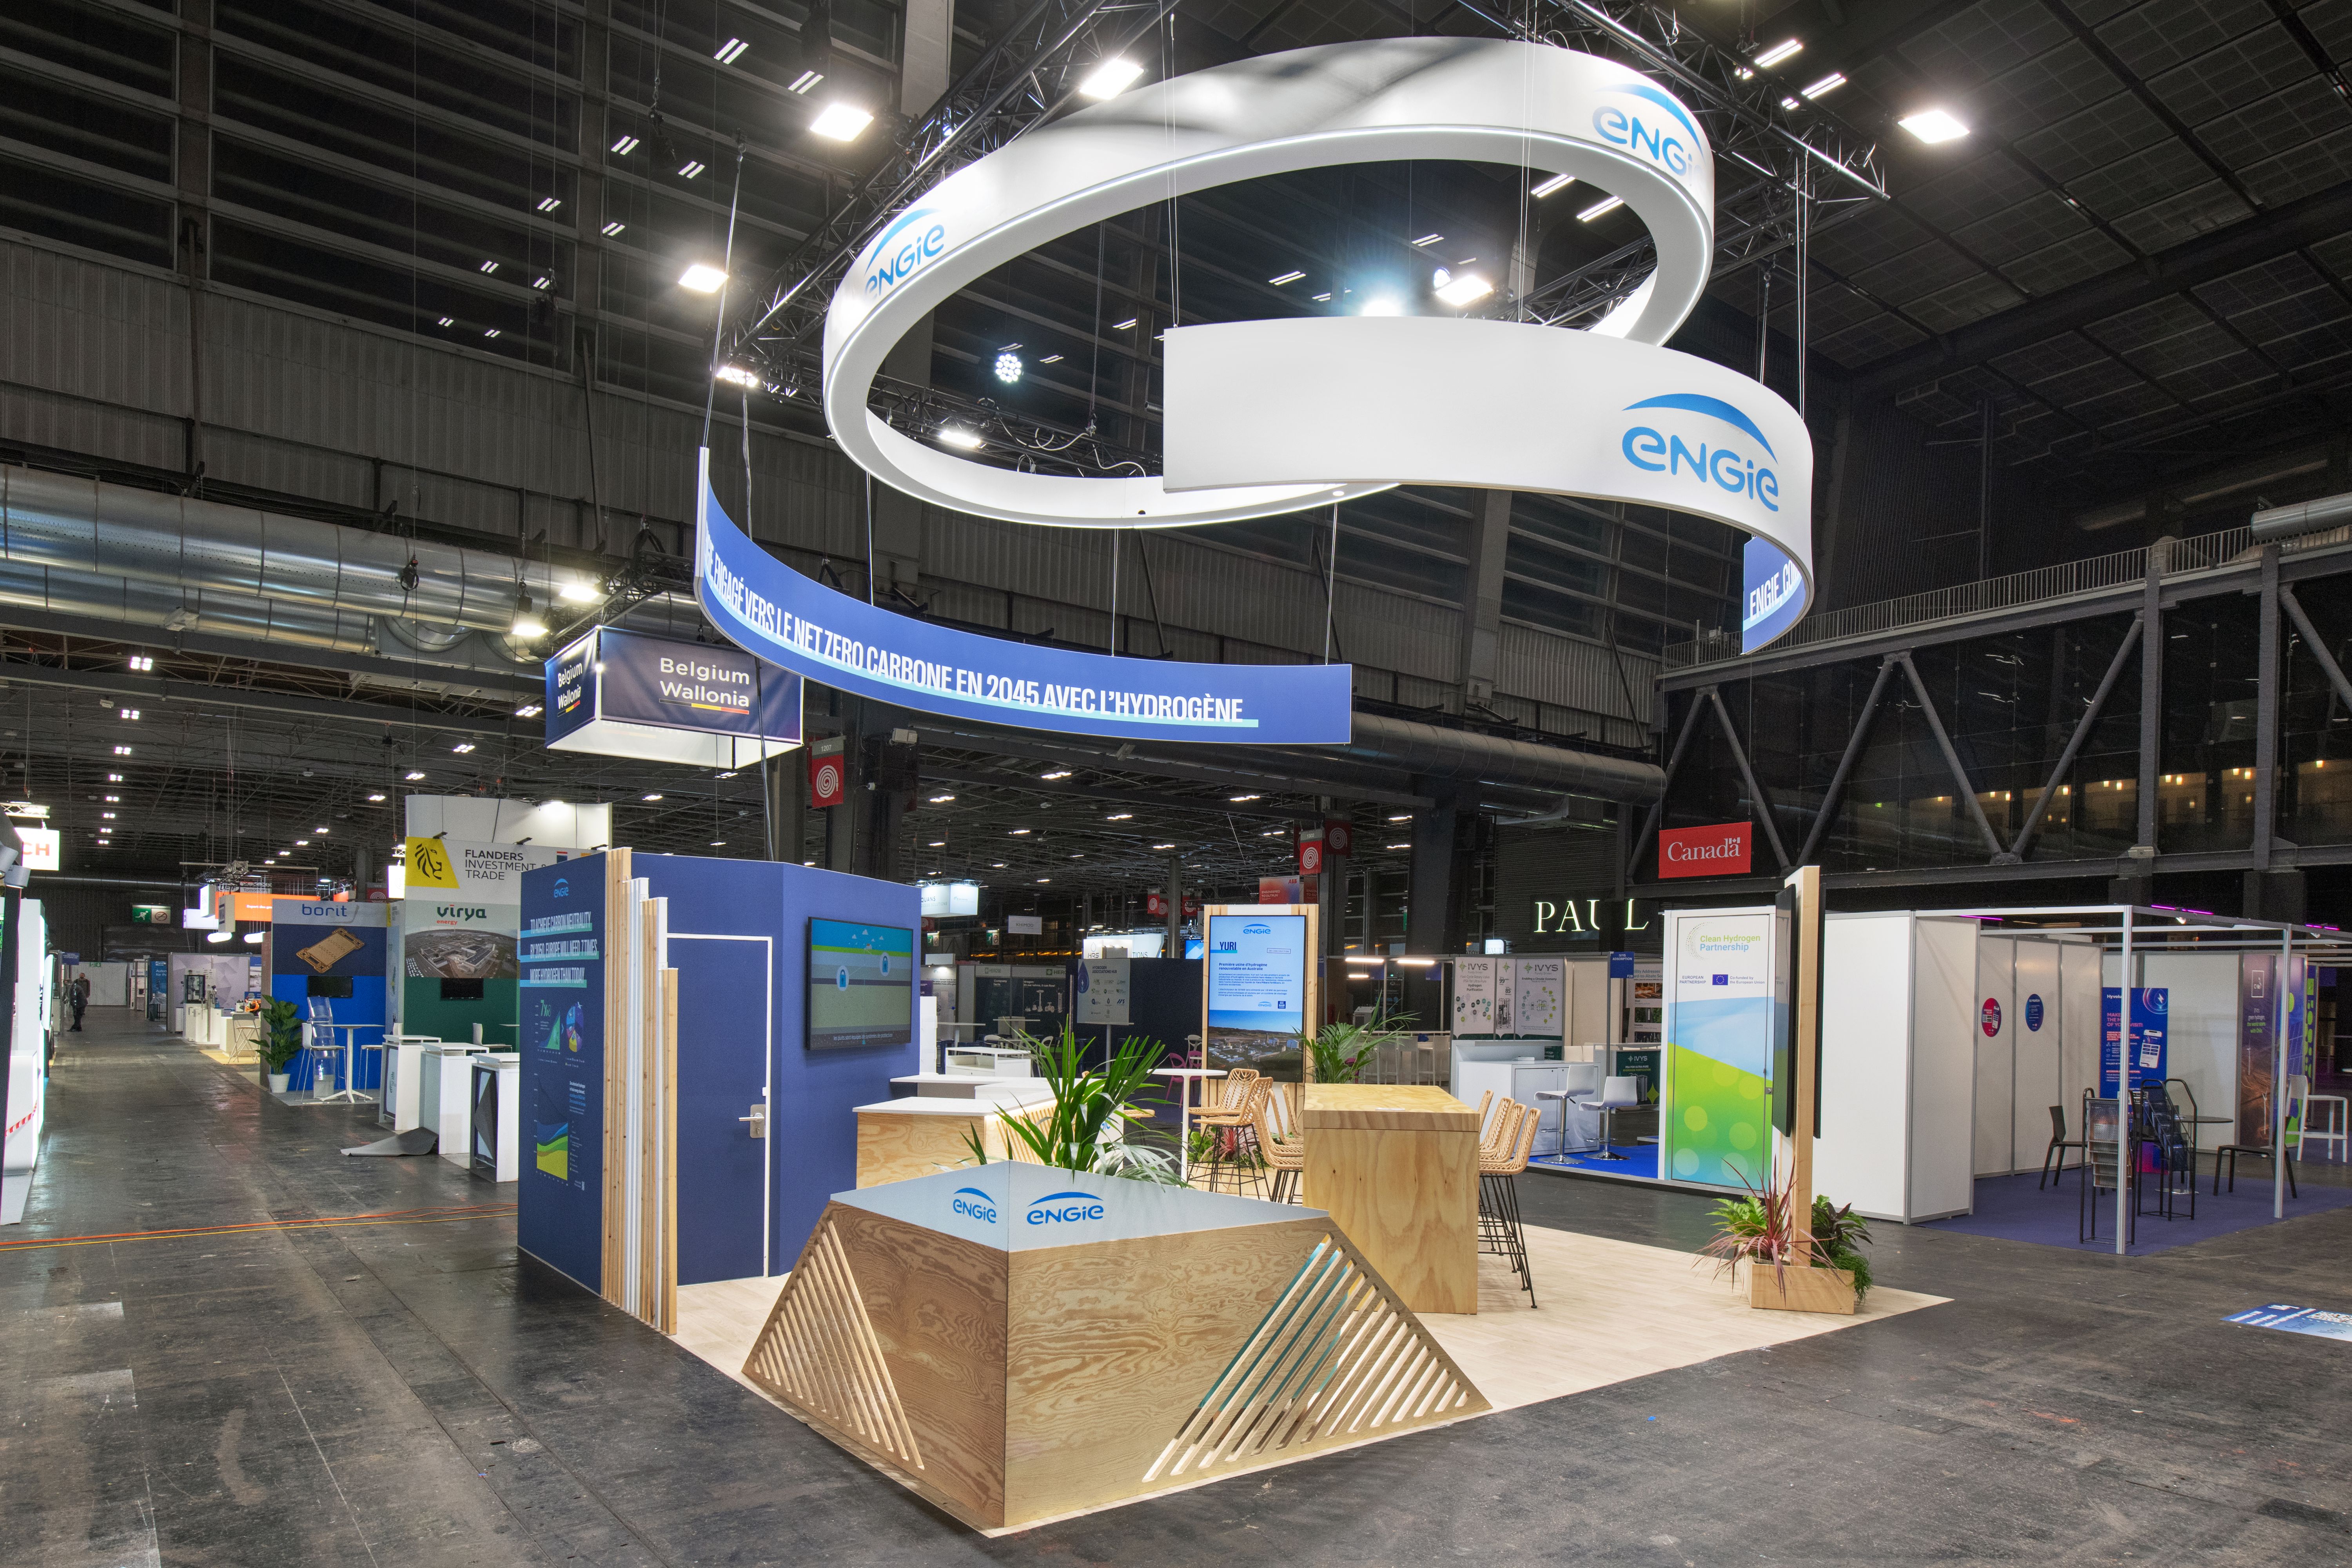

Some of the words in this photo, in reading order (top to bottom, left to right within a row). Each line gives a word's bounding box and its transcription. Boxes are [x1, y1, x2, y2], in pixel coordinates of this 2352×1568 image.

[1750, 572, 1782, 622] ENGIE,
[713, 552, 744, 615] ENGAGÉ
[744, 586, 775, 635] VERS
[777, 608, 791, 644] LE
[793, 617, 823, 656] NET
[823, 630, 864, 670] ZERO
[866, 646, 952, 693] CARBONE
[956, 669, 982, 698] EN
[986, 674, 1039, 707] 2045
[1043, 683, 1096, 714] AVEC
[558, 662, 583, 688] Belgium
[660, 657, 750, 685] Belgium
[558, 684, 581, 710] Wallonia
[660, 681, 750, 707] Wallonia
[465, 849, 524, 861] FLANDERS
[1668, 837, 1741, 861] Canada
[465, 859, 536, 871] INVESTMENT
[465, 869, 505, 880] TRADE
[302, 904, 347, 916] borit
[535, 917, 550, 934] ACHIEVE
[550, 914, 566, 932] CARBON
[566, 911, 591, 929] NEUTRALITY
[546, 941, 560, 958] EUROPE
[560, 940, 569, 957] WILL
[570, 940, 580, 956] NEED
[581, 940, 584, 956] 7
[584, 939, 597, 956] TIMES
[1220, 942, 1236, 950] YURI
[1700, 943, 1749, 952] Partnership
[1723, 935, 1760, 943] Hydrogen
[530, 969, 540, 984] MORE
[540, 967, 561, 984] HYDROGEN
[561, 967, 572, 984] THAN
[572, 967, 585, 984] TODAY
